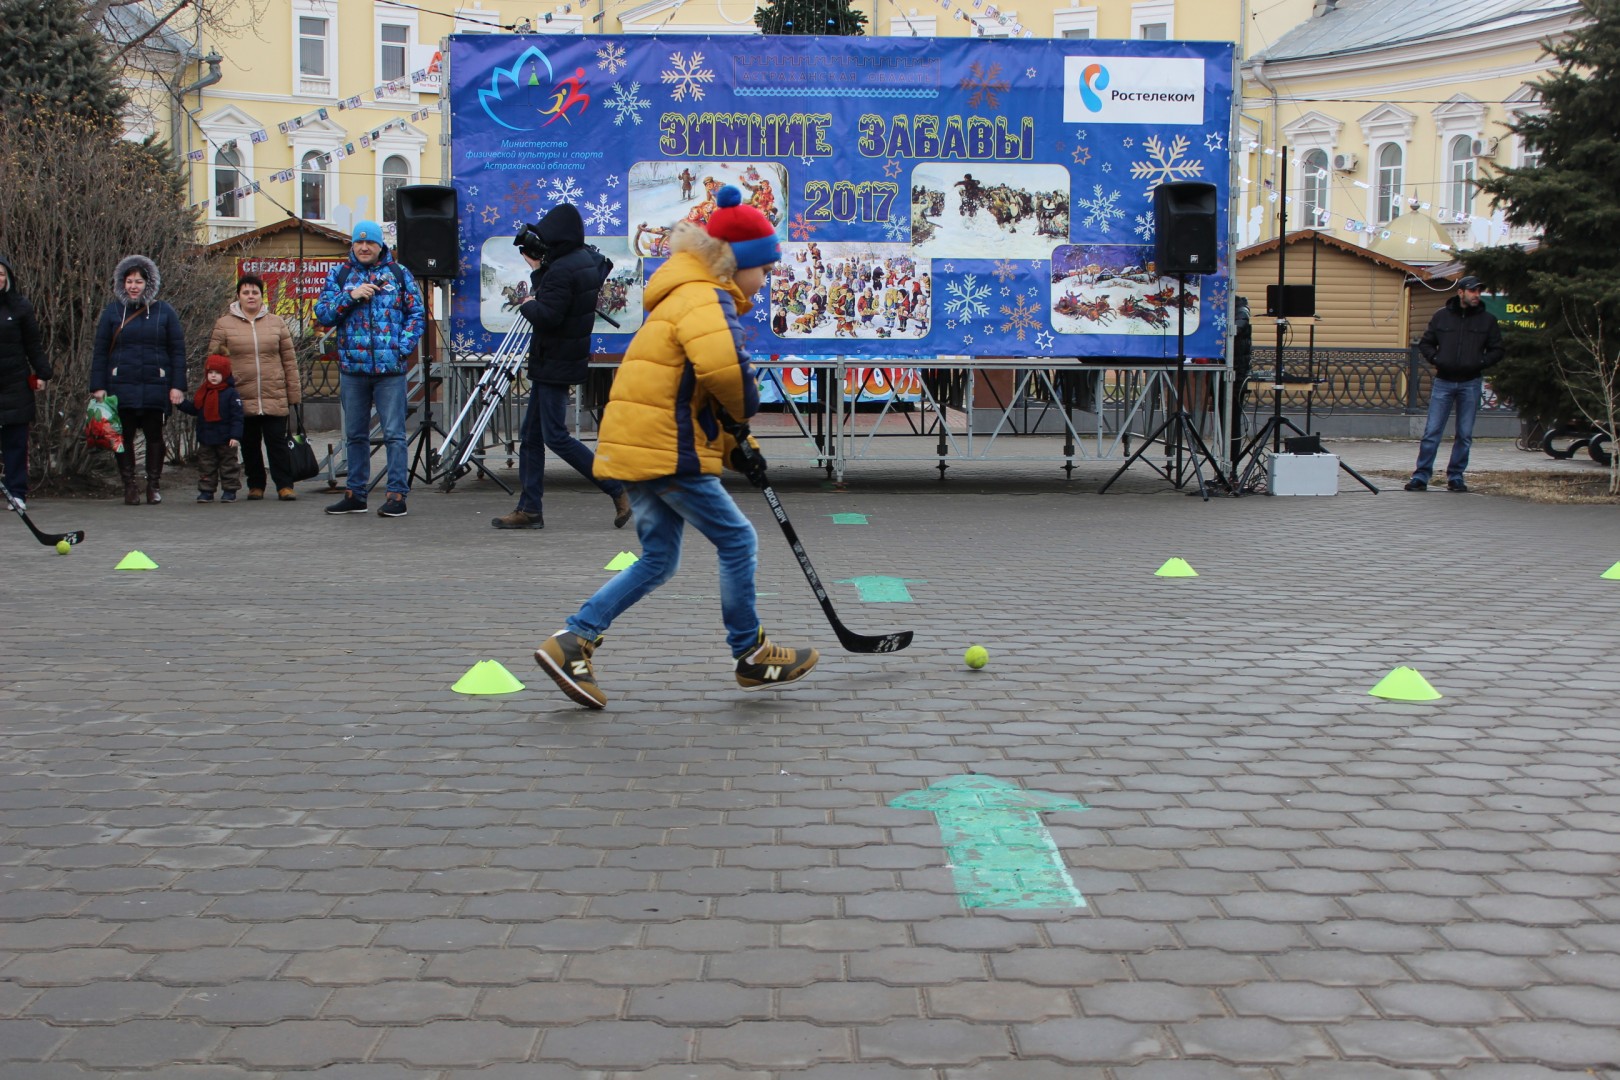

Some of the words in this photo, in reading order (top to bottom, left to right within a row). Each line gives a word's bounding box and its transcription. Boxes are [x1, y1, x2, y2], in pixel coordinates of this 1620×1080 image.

[742, 71, 857, 82] АСТРАХАНСКАЯ
[868, 71, 931, 83] ОБЛАСТЬ
[1111, 90, 1195, 102] Ростелеком
[659, 112, 832, 157] ЗИМНИЕ
[858, 113, 1034, 160] ЗАБАВЫ
[501, 139, 568, 150] Министерство
[465, 150, 516, 159] физической
[518, 151, 560, 160] культуры
[570, 151, 604, 160] спорта
[484, 161, 546, 172] Астраханской
[547, 161, 586, 171] области
[804, 180, 899, 223] 2017
[242, 261, 296, 273] СВЕЖАЯ
[763, 486, 780, 508] SOCHI
[773, 506, 788, 524] 2014
[569, 659, 589, 676] N
[763, 664, 783, 681] N
